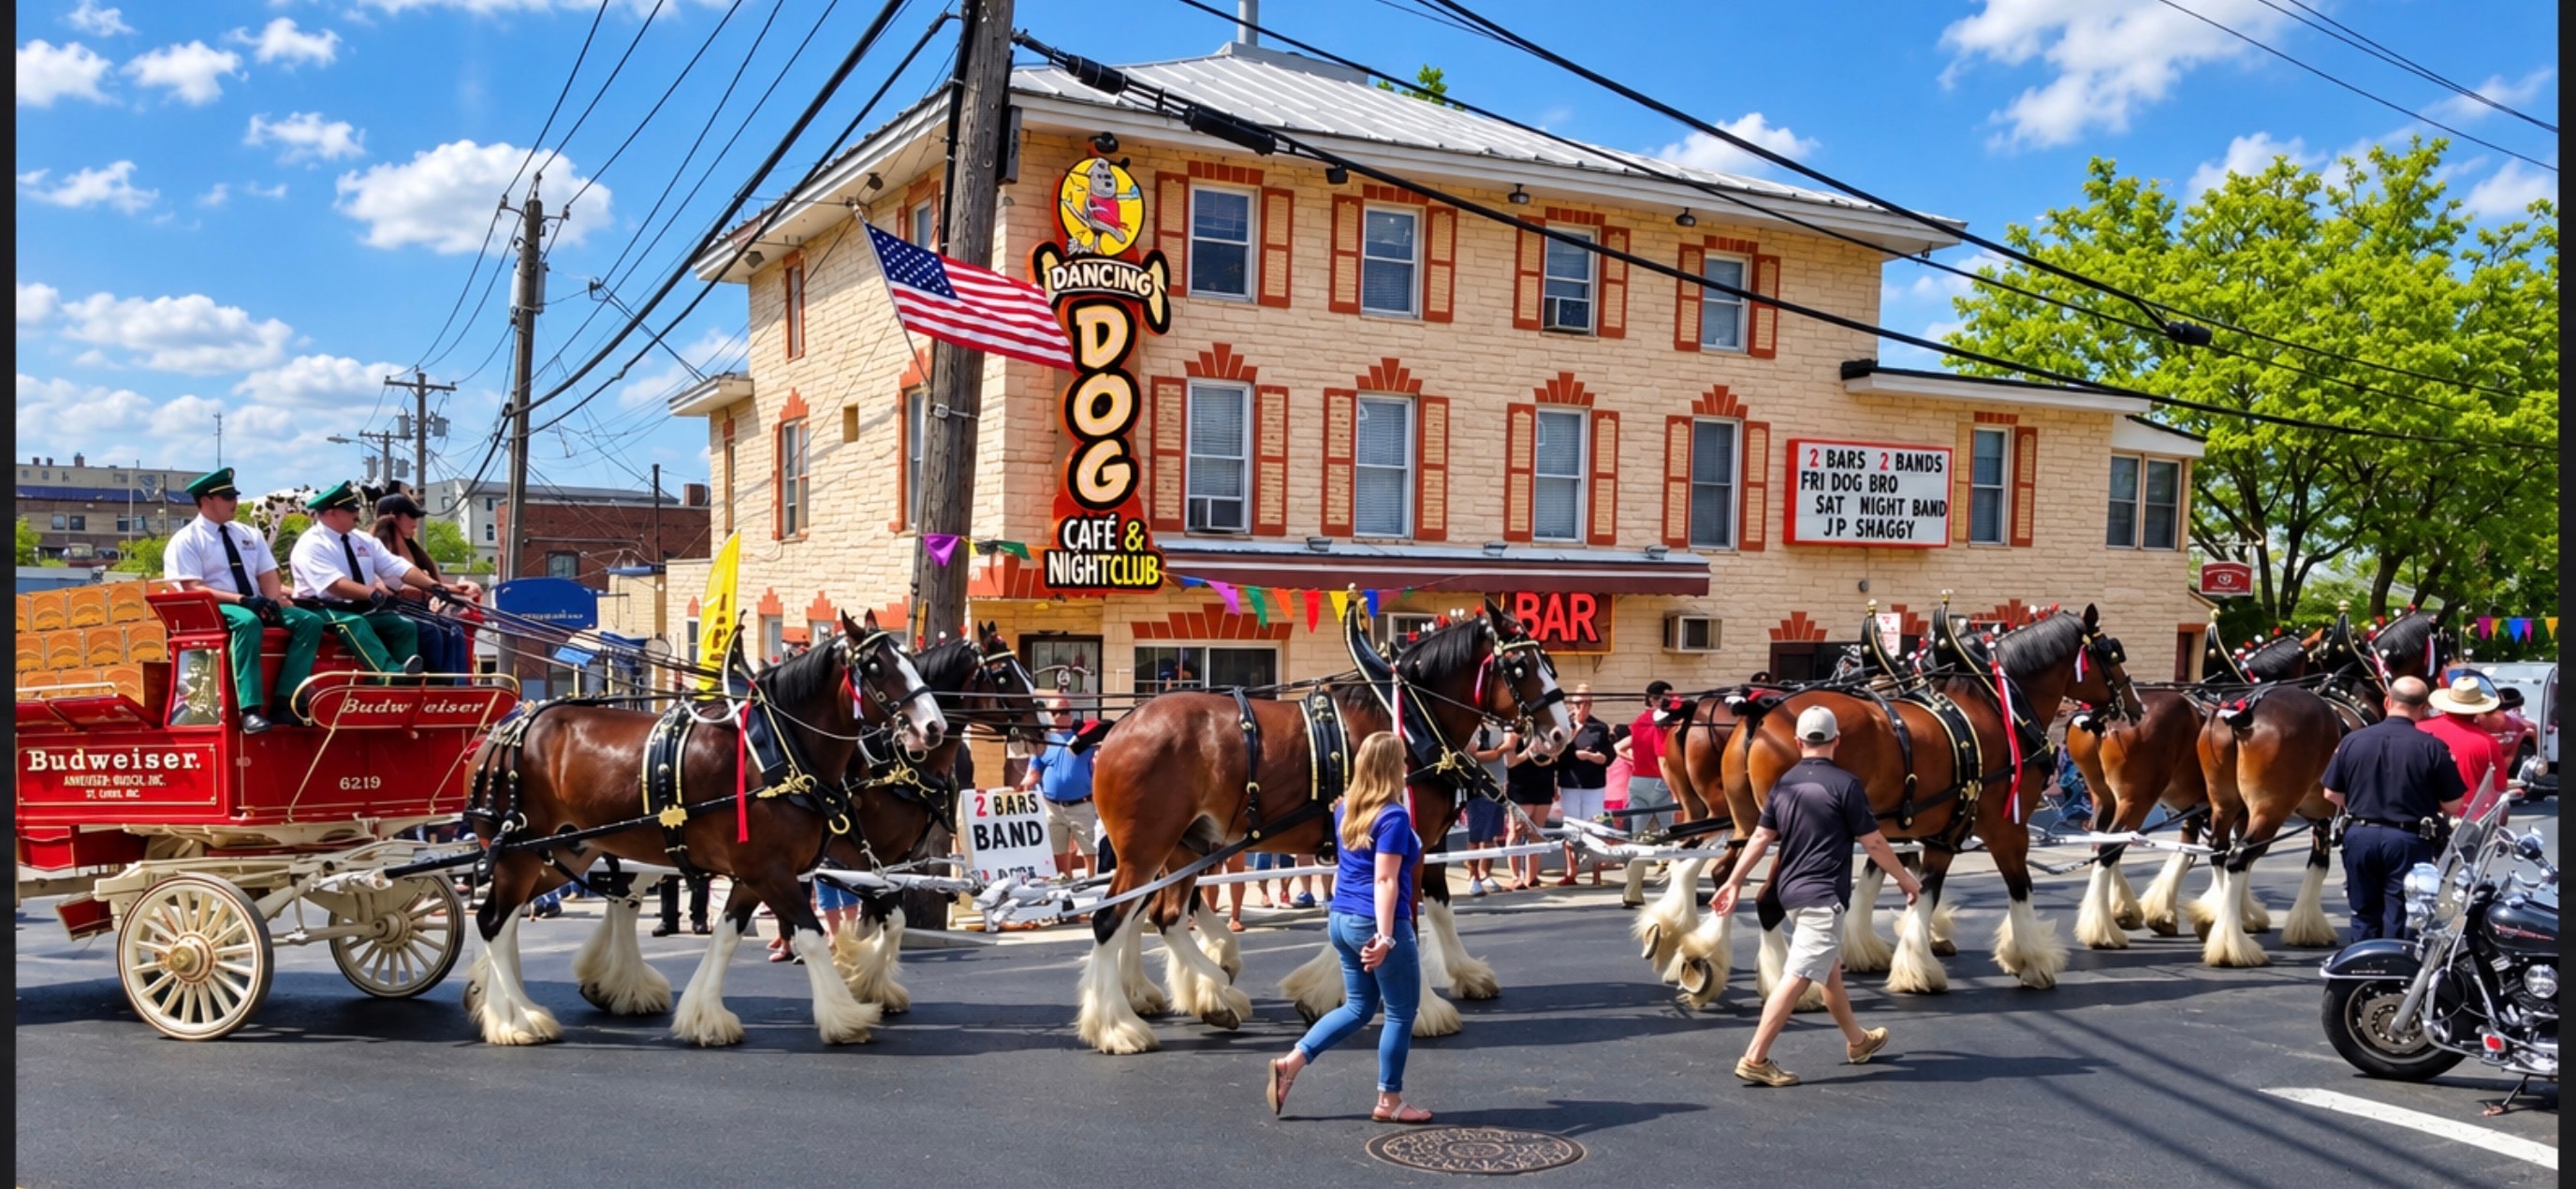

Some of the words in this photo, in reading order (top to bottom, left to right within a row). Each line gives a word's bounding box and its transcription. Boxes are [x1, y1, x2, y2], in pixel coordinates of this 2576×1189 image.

[1050, 263, 1152, 296] DANCING
[1074, 304, 1133, 503] DOG
[1808, 448, 1819, 467] 2
[1826, 449, 1866, 469] BARS
[1880, 452, 1889, 470] 2
[1895, 453, 1943, 473] BANDS
[1801, 471, 1824, 491] FRI
[1831, 472, 1863, 492] DOG
[1869, 474, 1898, 493] BRO
[1815, 494, 1845, 515] SAT
[1860, 496, 1906, 517] NIGHT
[1912, 499, 1948, 518] BAND
[1063, 514, 1117, 551] CAFÉ
[1124, 521, 1144, 552] &
[1048, 551, 1159, 585] NIGHTCLUB
[1515, 592, 1599, 642] BAR
[26, 746, 201, 771] Budweiser.
[339, 775, 382, 790] 6219
[974, 795, 988, 817] 2
[993, 793, 1039, 816] BARS
[973, 820, 1044, 851] BAND
